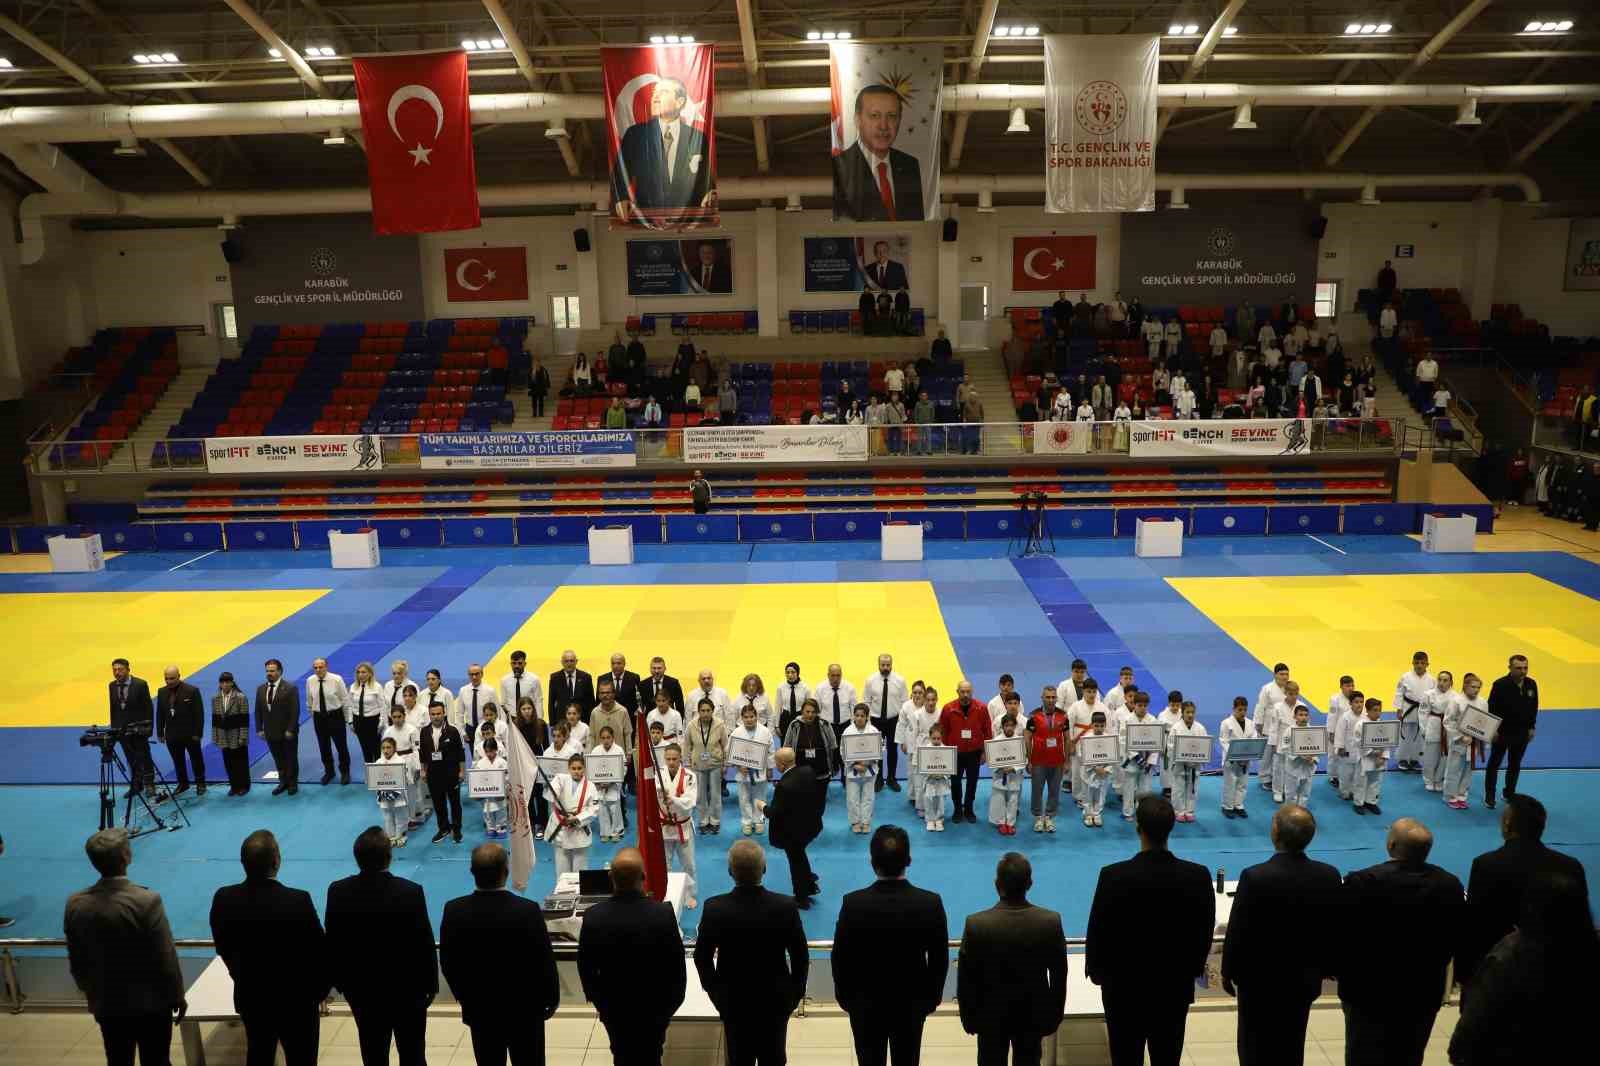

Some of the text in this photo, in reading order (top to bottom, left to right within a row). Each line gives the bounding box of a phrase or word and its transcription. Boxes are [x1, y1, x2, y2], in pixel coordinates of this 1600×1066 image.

[1050, 143, 1072, 153] T.C.
[1135, 142, 1151, 152] VE
[1049, 154, 1151, 168] SPOR BAKANLIĞI
[1196, 258, 1243, 270] KARABÜK
[304, 277, 349, 289] KARABÜK
[1141, 272, 1296, 286] GENÇLİK VE SPOR İL MÜDÜRLÜĞÜ
[254, 292, 294, 305] GENÇLİK
[295, 294, 306, 303] VE
[307, 294, 331, 303] SPOR
[343, 290, 403, 302] MÜDÜRLÜĞÜ
[422, 432, 633, 445] TÜM TAKIMLARIMIZA VE SPORCULARIMIZA
[1183, 428, 1224, 439] BENCH
[256, 444, 297, 456] BENCH
[472, 445, 536, 456] BAŞARILAR
